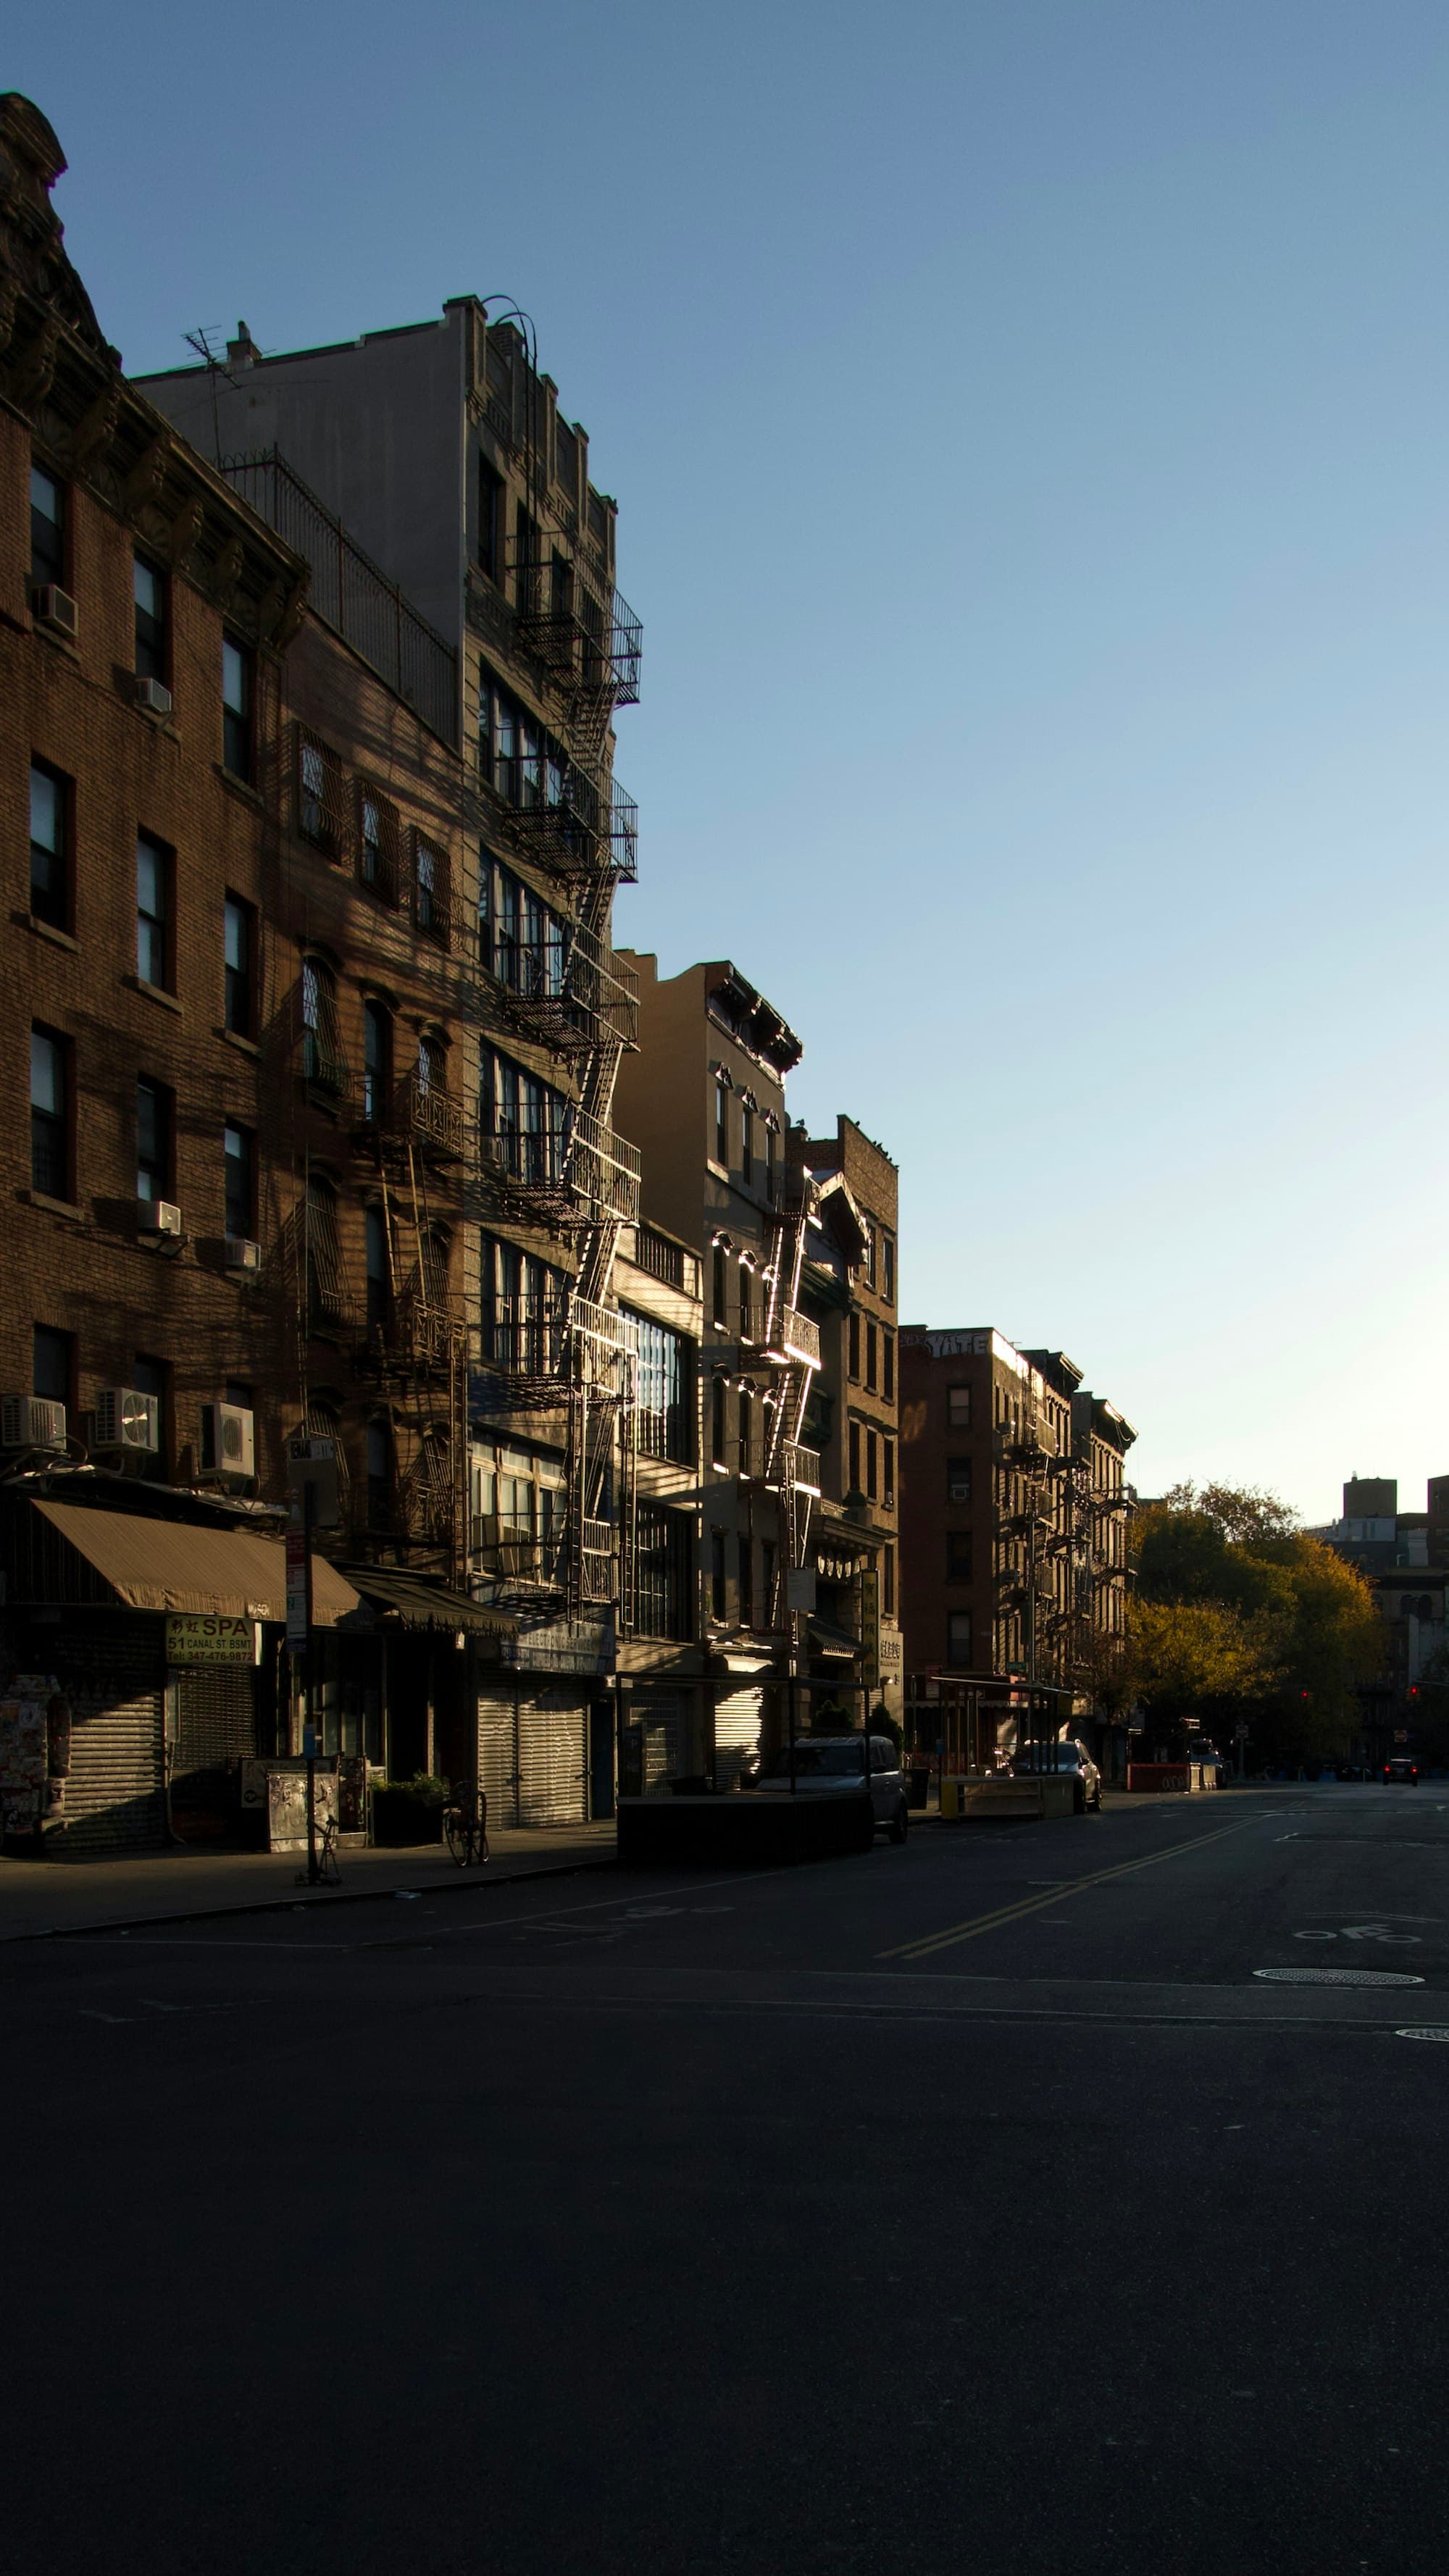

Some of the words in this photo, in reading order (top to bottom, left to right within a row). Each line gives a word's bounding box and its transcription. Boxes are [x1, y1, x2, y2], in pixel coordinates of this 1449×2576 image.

[203, 1619, 248, 1636] SPA
[168, 1637, 185, 1649] 51
[187, 1639, 214, 1649] CANAL
[216, 1639, 228, 1649] ST.
[230, 1639, 251, 1649] BSMT
[529, 1633, 565, 1649] ELECTRONIC
[167, 1652, 185, 1660] Tel:
[188, 1652, 254, 1660] 347-476-9872
